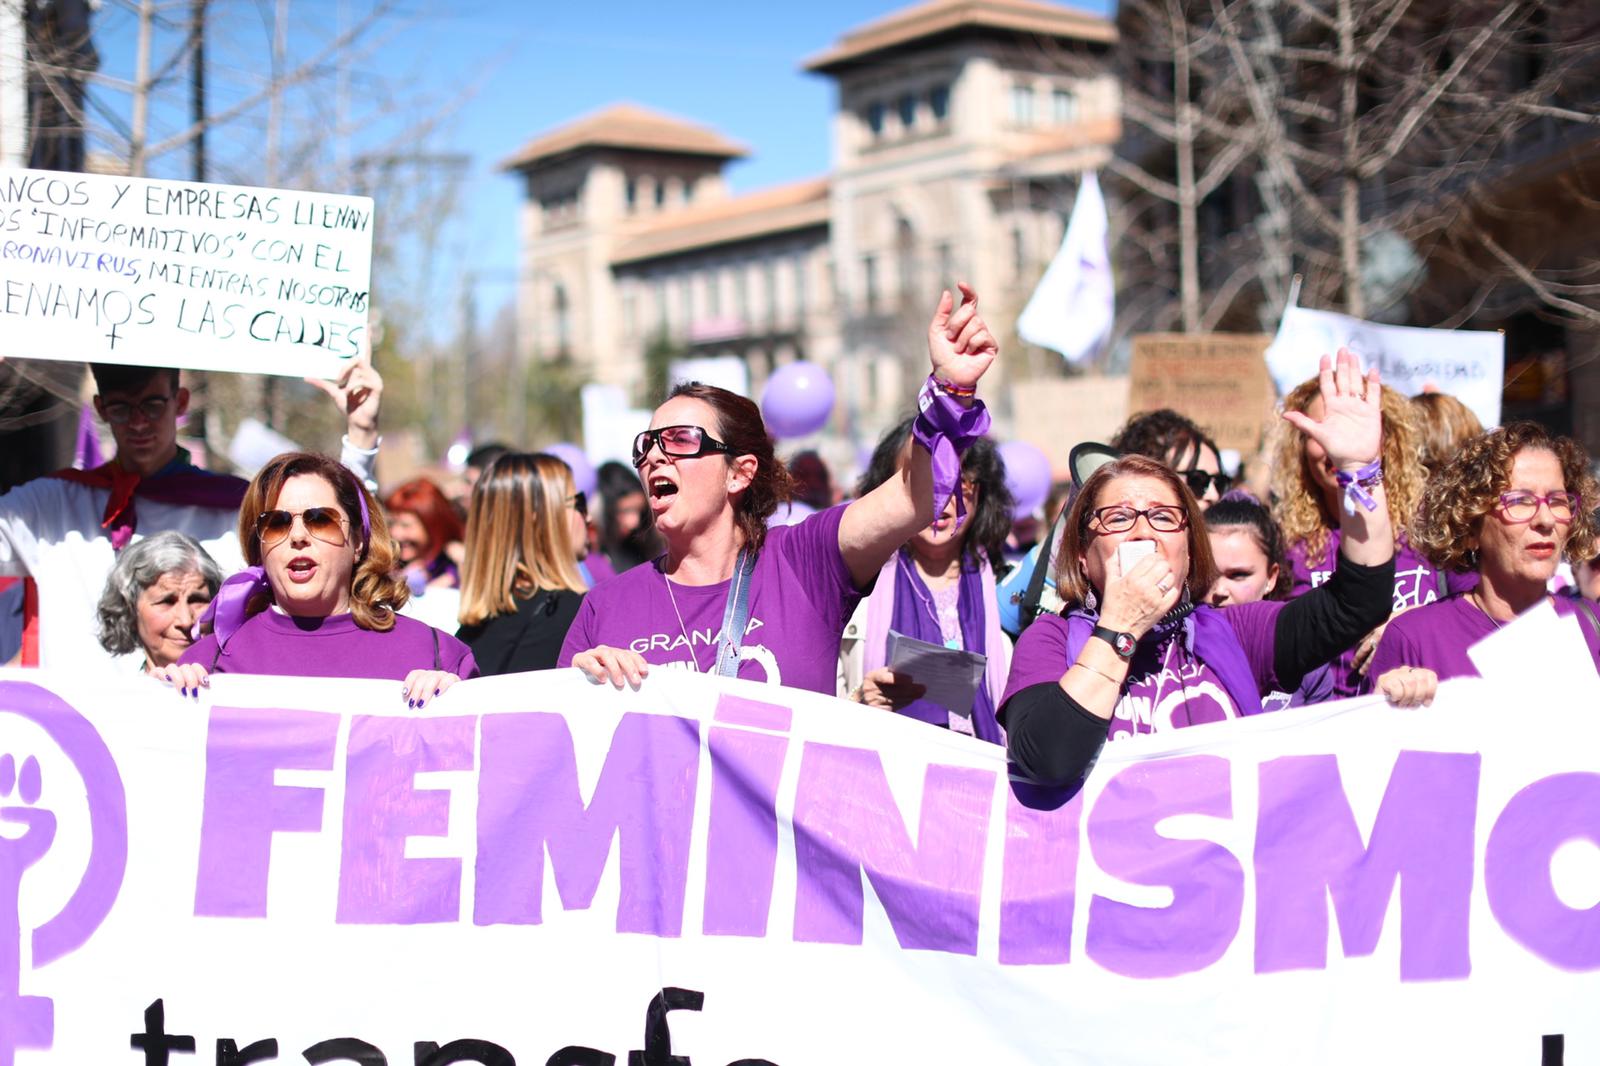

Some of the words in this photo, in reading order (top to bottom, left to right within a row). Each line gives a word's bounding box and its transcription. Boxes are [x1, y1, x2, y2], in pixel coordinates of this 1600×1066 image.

[111, 184, 131, 209] Y
[146, 185, 281, 224] EMPRESAS
[251, 239, 304, 264] CON
[314, 243, 350, 272] EL
[149, 261, 269, 296] MIENTRAS
[0, 279, 156, 349] ENAMOS
[177, 298, 245, 339] LAS
